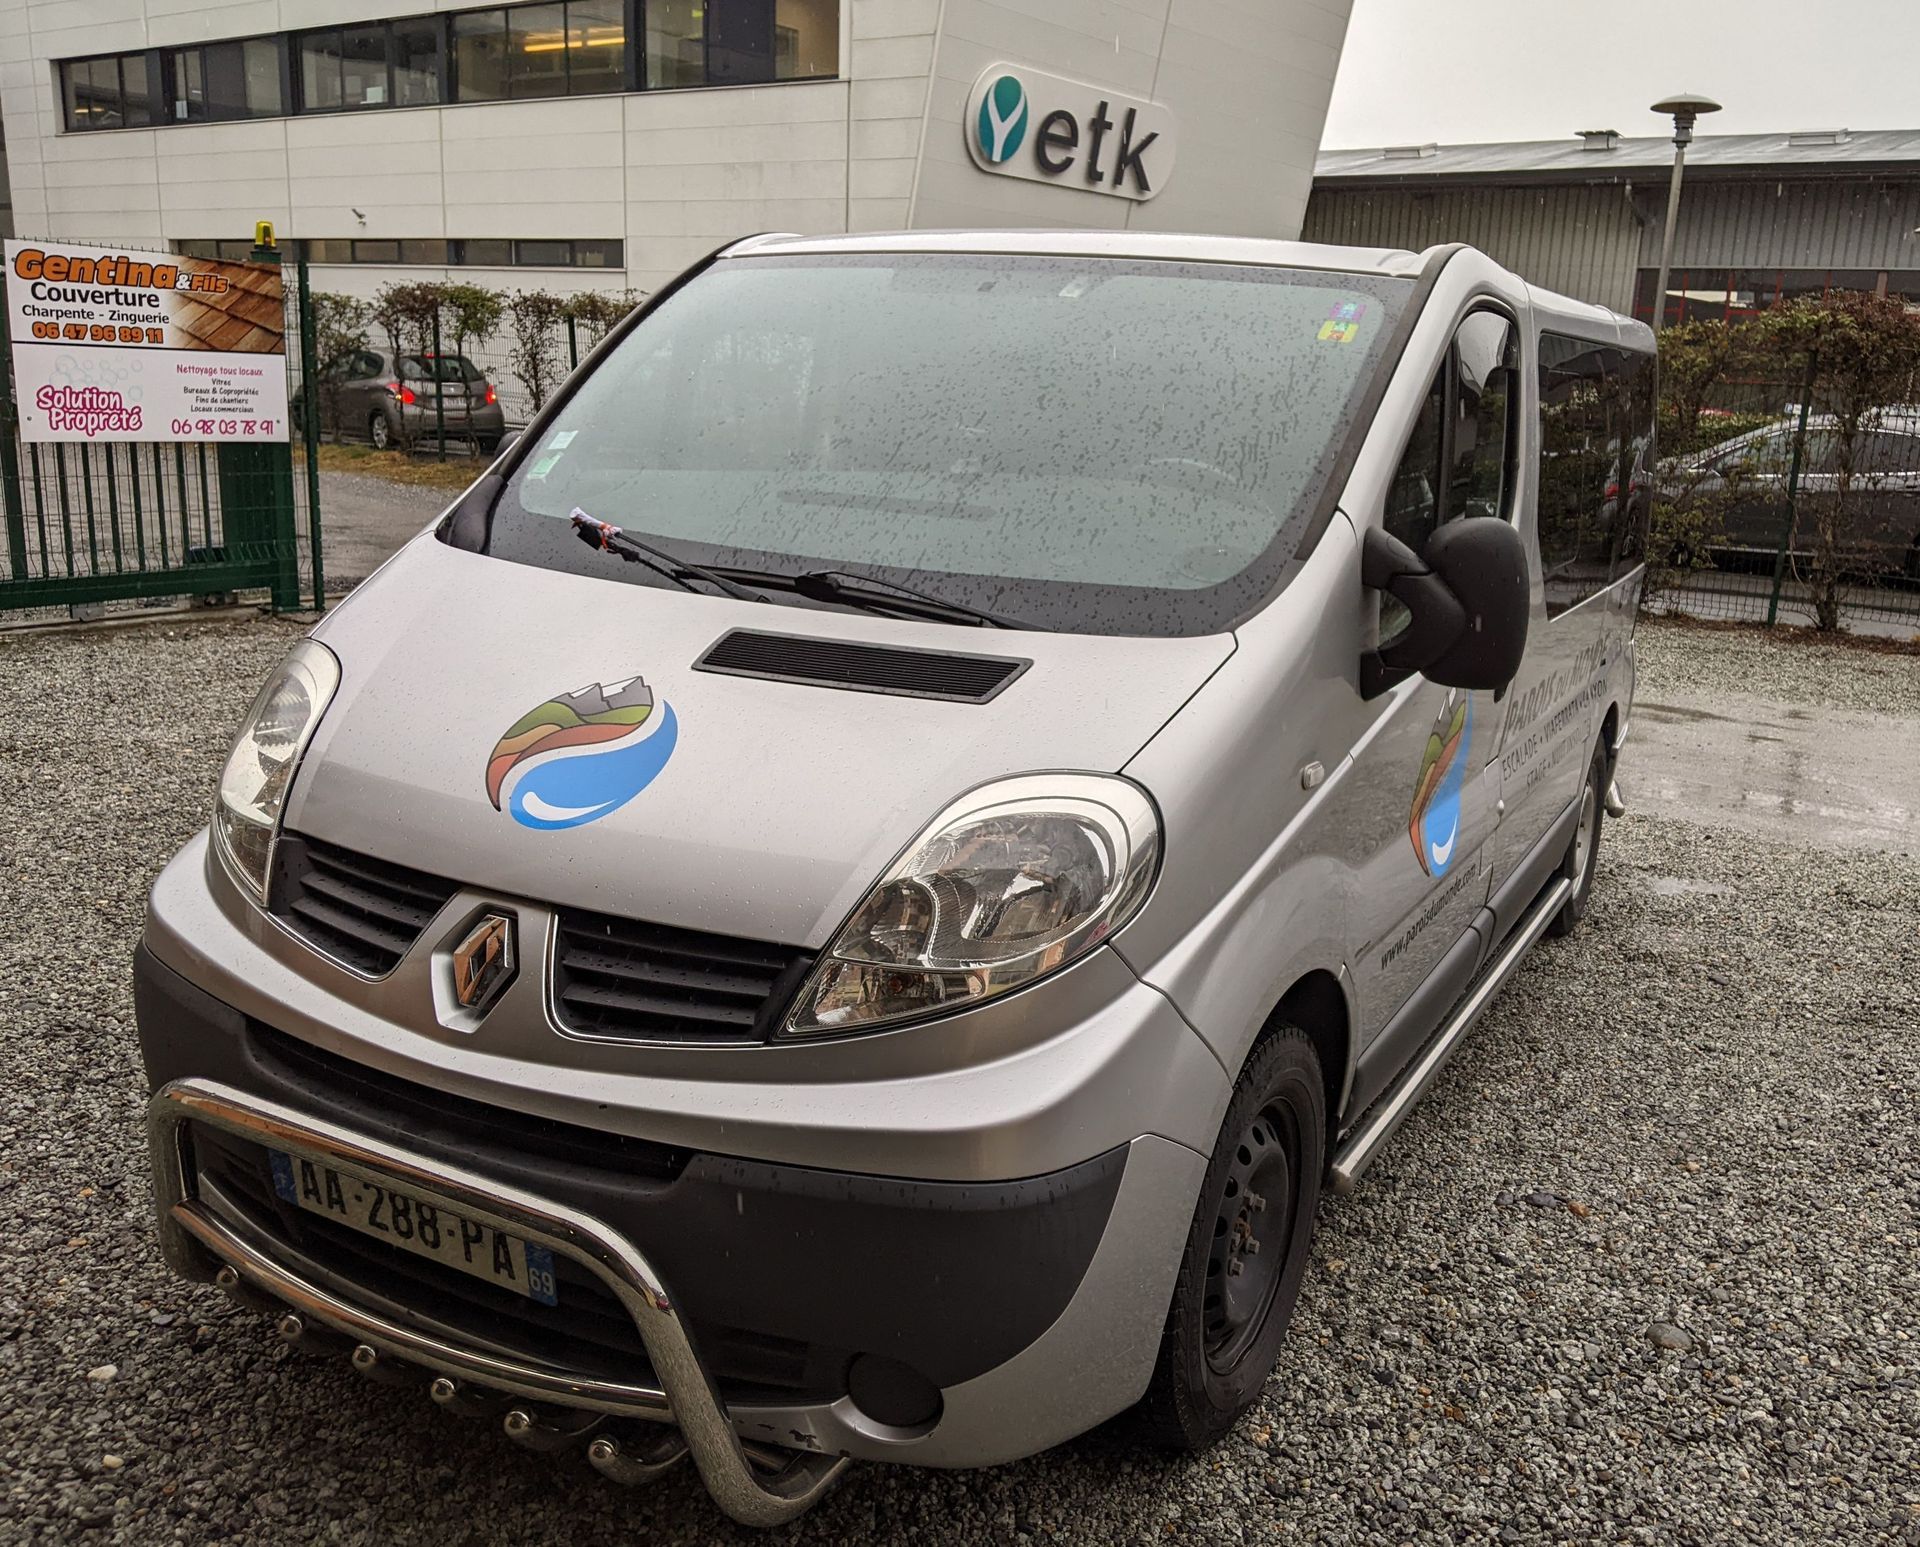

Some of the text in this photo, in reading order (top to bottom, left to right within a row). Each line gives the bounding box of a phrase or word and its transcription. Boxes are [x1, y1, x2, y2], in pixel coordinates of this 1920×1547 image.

[1036, 100, 1159, 192] etk
[31, 281, 160, 308] Couverture
[22, 304, 94, 325] Charpente
[108, 309, 170, 325] Zinguerie
[32, 321, 164, 343] 06 47 96 89 11
[176, 364, 264, 376] Nettoyage tous locaux
[183, 386, 210, 395] Bureaux
[219, 387, 259, 396] Copropriétés
[211, 378, 232, 386] Vitres
[36, 385, 122, 411] Solution
[190, 404, 254, 413] Locaux commerciaux
[195, 395, 249, 404] Fins de chantiers
[49, 406, 143, 437] Propreté
[171, 419, 273, 435] 06 98 03 78 91
[1502, 733, 1538, 781] ESCALADE
[529, 1266, 555, 1296] 69
